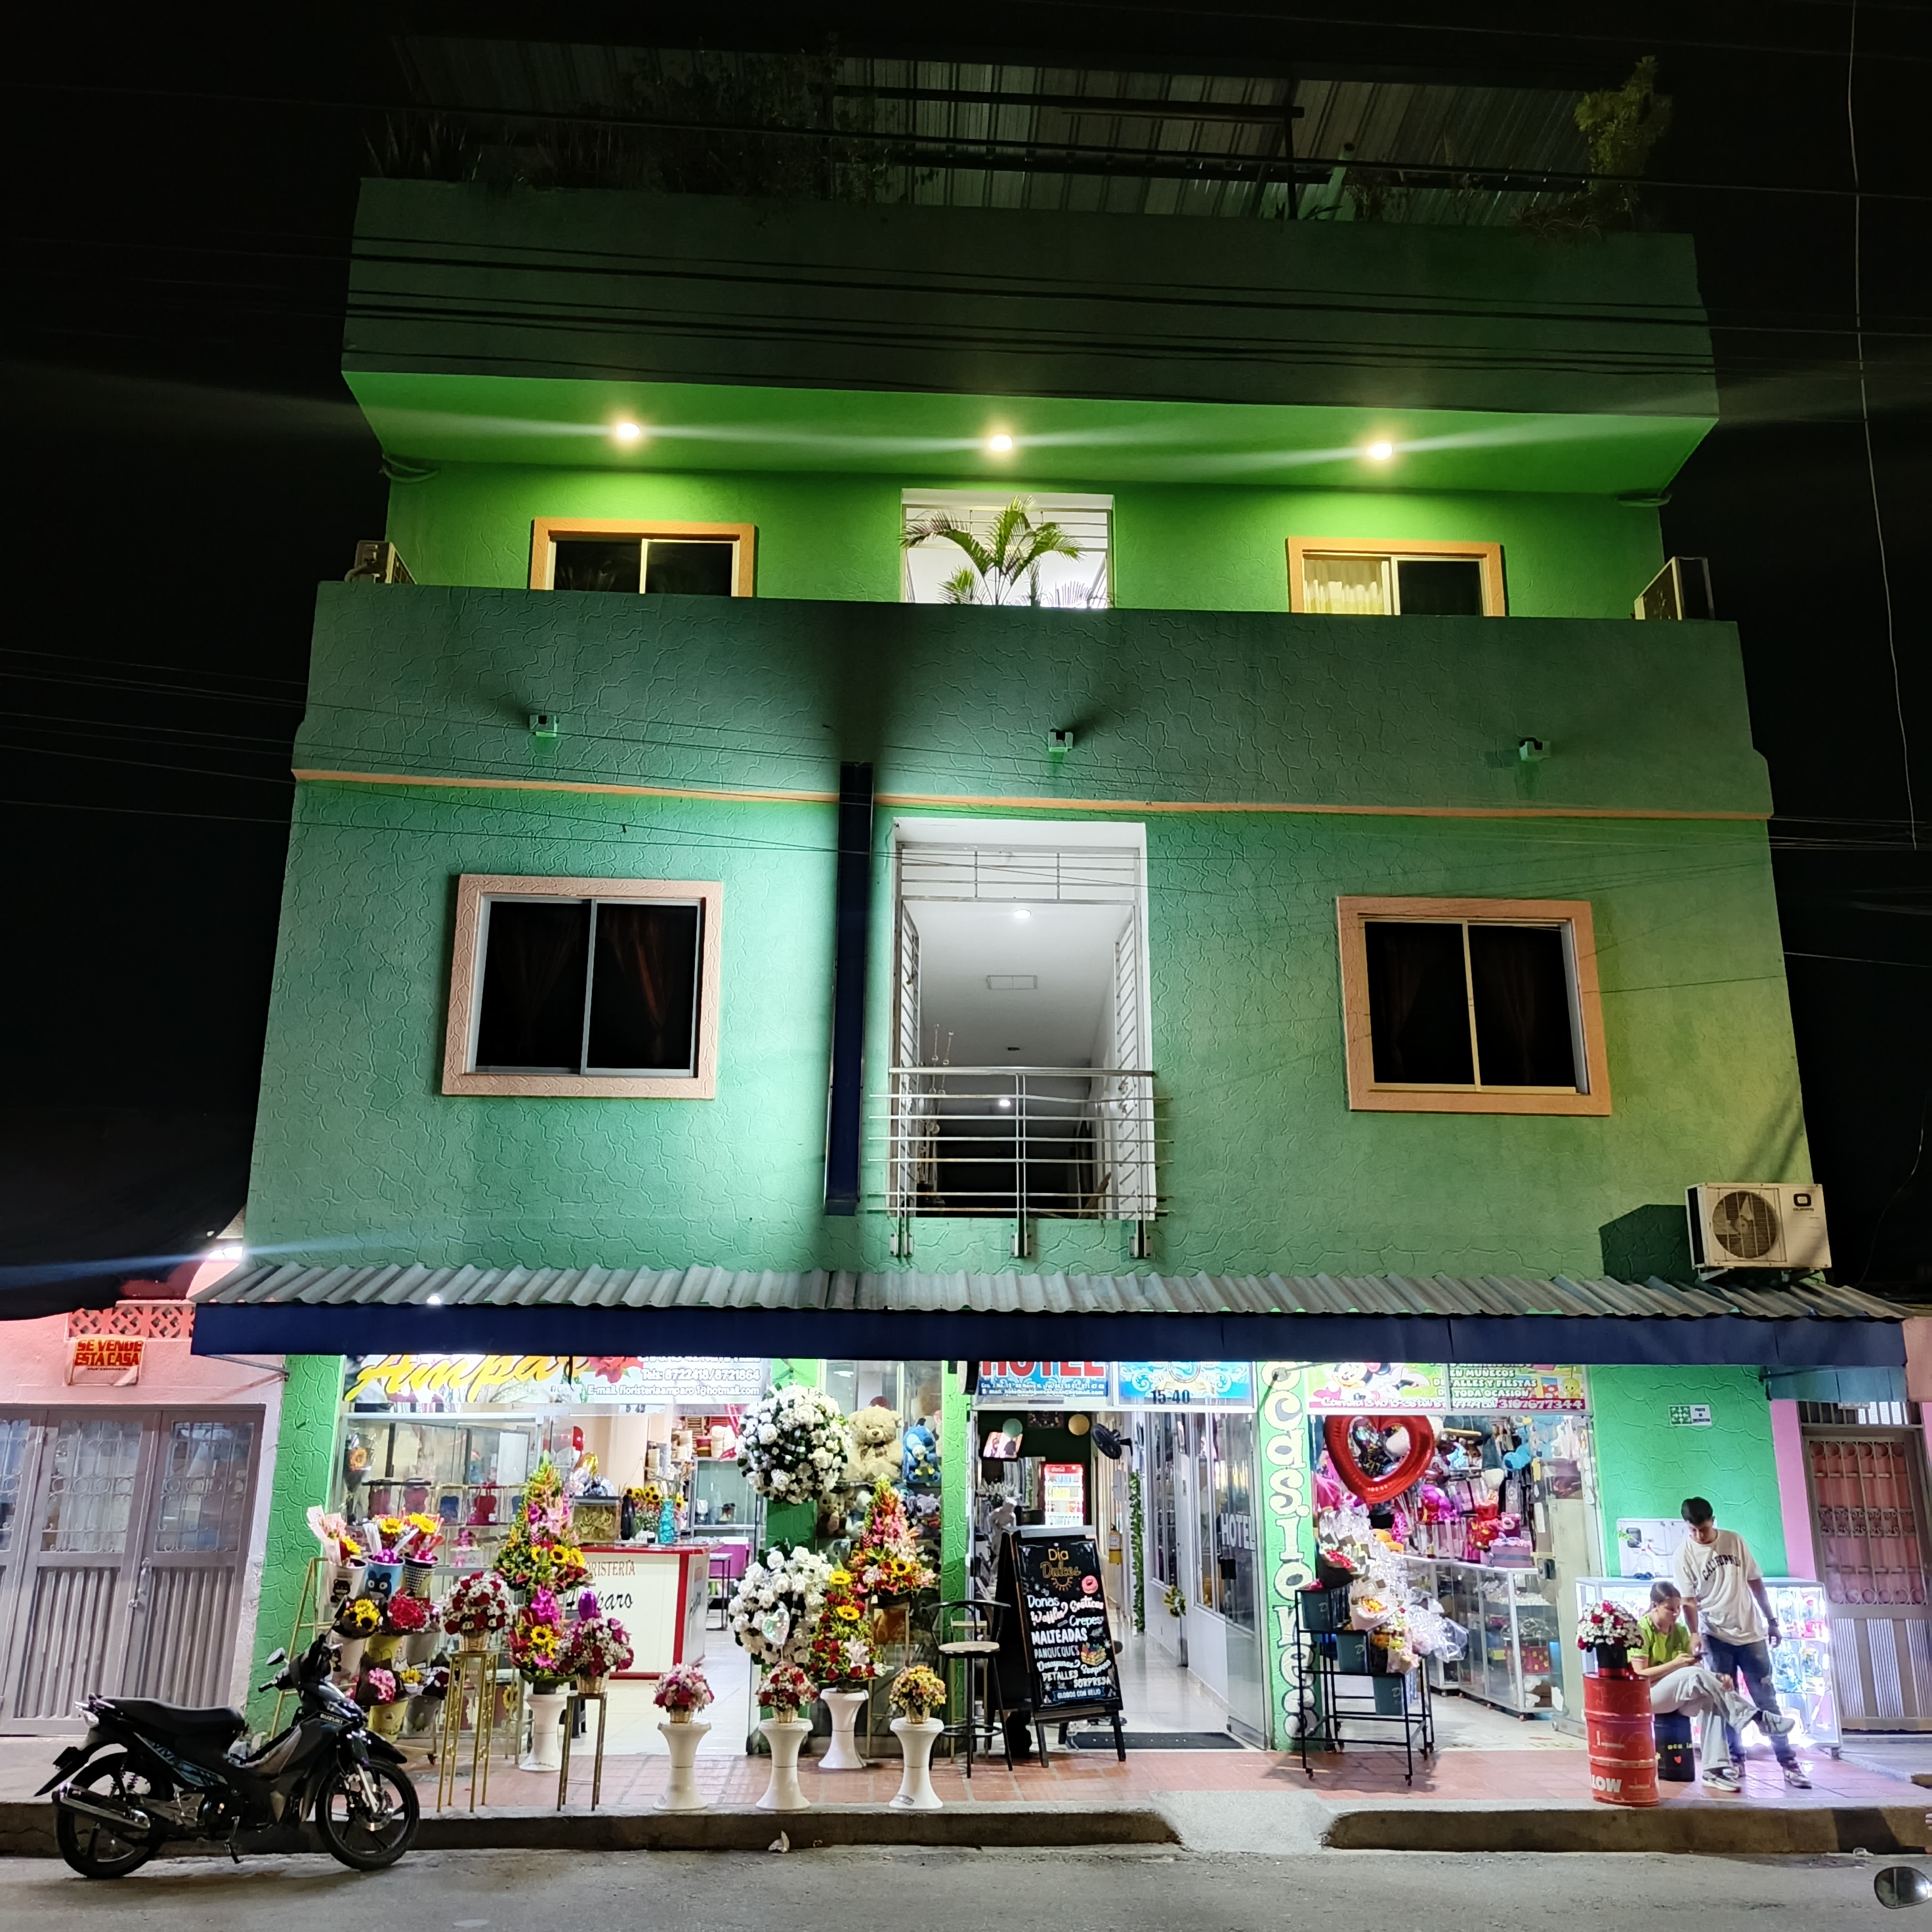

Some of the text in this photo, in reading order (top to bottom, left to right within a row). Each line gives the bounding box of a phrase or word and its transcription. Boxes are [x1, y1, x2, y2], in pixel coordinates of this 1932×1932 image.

[77, 1339, 143, 1352] SE VENDE
[74, 1353, 139, 1366] ESTA CASA
[343, 1354, 595, 1403] Ampar
[1465, 1368, 1516, 1377] MUÑECOS
[1486, 1379, 1494, 1387] Y
[1496, 1379, 1538, 1388] FIESTAS
[1152, 1389, 1190, 1405] 15-40
[1454, 1389, 1483, 1398] TODA
[1498, 1399, 1584, 1410] 3107677344
[1221, 1513, 1255, 1550] HOTEL
[1040, 1560, 1082, 1578] Dulces
[1702, 1555, 1741, 1581] CALIFORNI
[566, 1587, 634, 1611] Aparo
[1026, 1595, 1060, 1608] Donas
[1030, 1602, 1104, 1628] Waffles Crepes
[1031, 1628, 1088, 1645] MALTEADAS
[1034, 1645, 1080, 1659] PANQUEQUES
[1041, 1670, 1079, 1682] DETALLES
[1074, 1676, 1112, 1688] SORPRESA
[320, 1713, 343, 1725] SUZUKI
